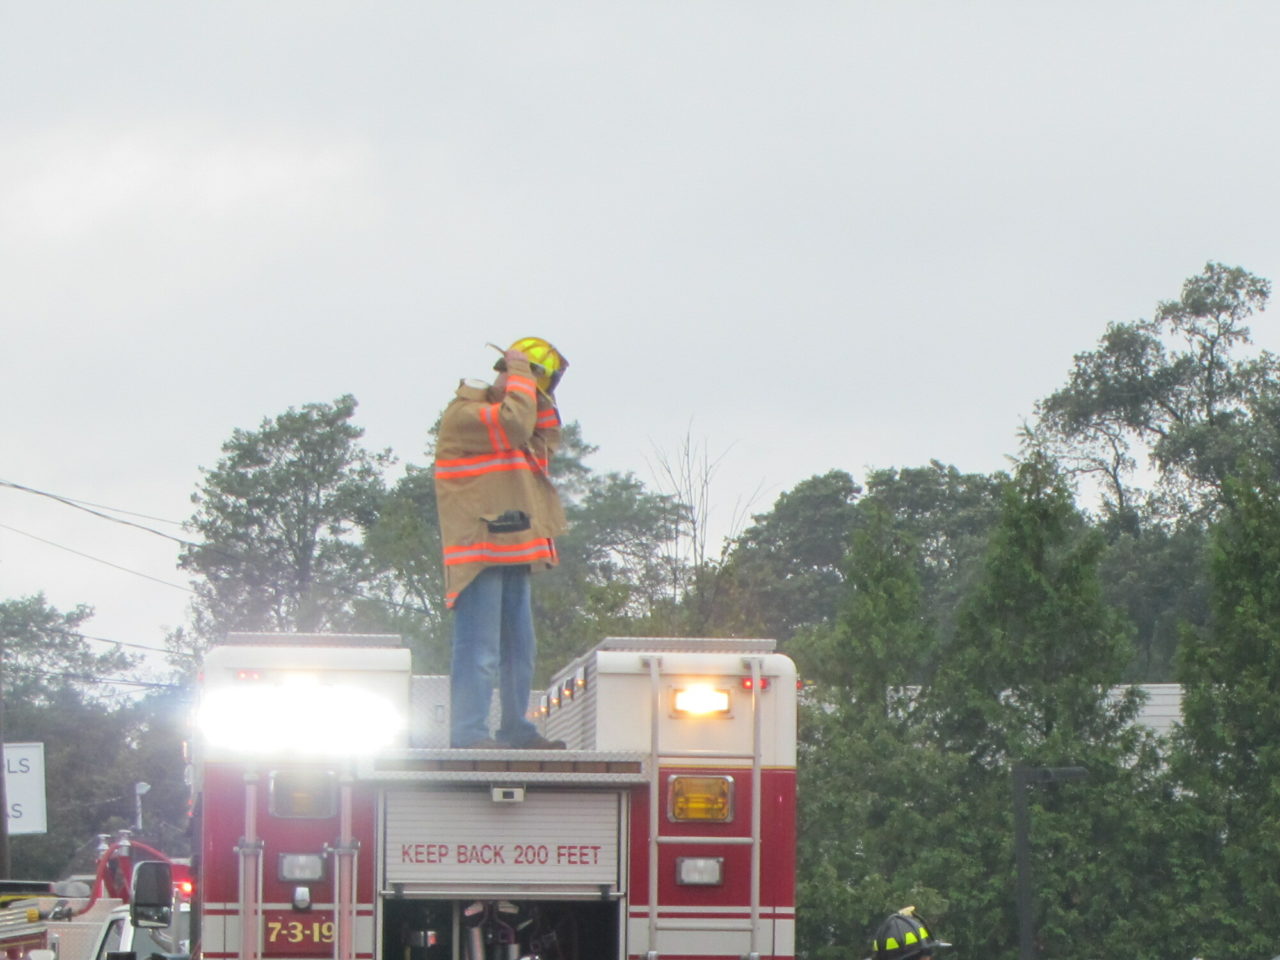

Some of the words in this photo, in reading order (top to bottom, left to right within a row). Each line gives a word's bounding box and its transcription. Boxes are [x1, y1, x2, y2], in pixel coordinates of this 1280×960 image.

[401, 844, 449, 864] KEEP
[456, 845, 505, 864] BACK
[514, 845, 549, 864] 200
[556, 845, 602, 864] FEET
[267, 921, 336, 943] 7-3-19
